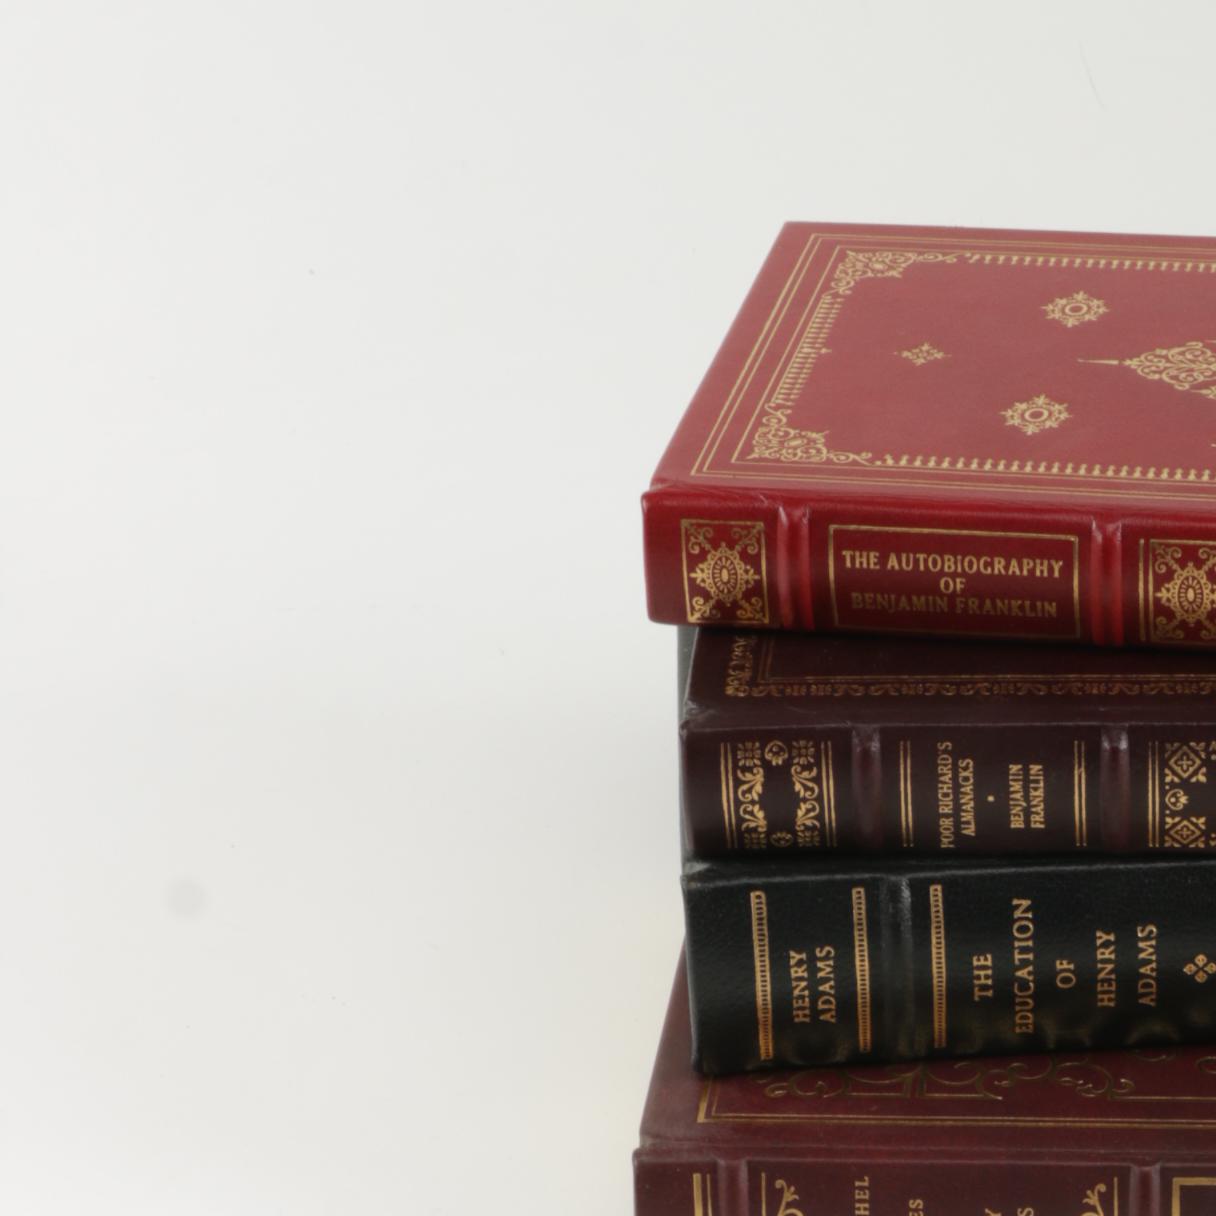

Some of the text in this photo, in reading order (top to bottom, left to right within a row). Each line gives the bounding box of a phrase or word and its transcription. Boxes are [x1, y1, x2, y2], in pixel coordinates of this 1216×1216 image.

[842, 550, 1063, 578] THE AUTOBIOGRAPHY
[939, 577, 966, 594] OF
[851, 592, 1057, 618] BENJAMIN FRANKLIN
[937, 741, 955, 848] POOR RICHARD'S
[958, 758, 976, 836] ALMANACKS
[1009, 764, 1027, 829] BENJAMIN
[1029, 764, 1045, 829] FRANKLIN
[789, 949, 811, 1024] HENRY
[817, 946, 836, 1024] ADAMS
[972, 953, 993, 1001] THE
[1012, 898, 1035, 1033] EDUCATION
[1055, 959, 1076, 989] OF
[1096, 930, 1116, 1007] HENRY
[1137, 924, 1158, 1007] ADAMS
